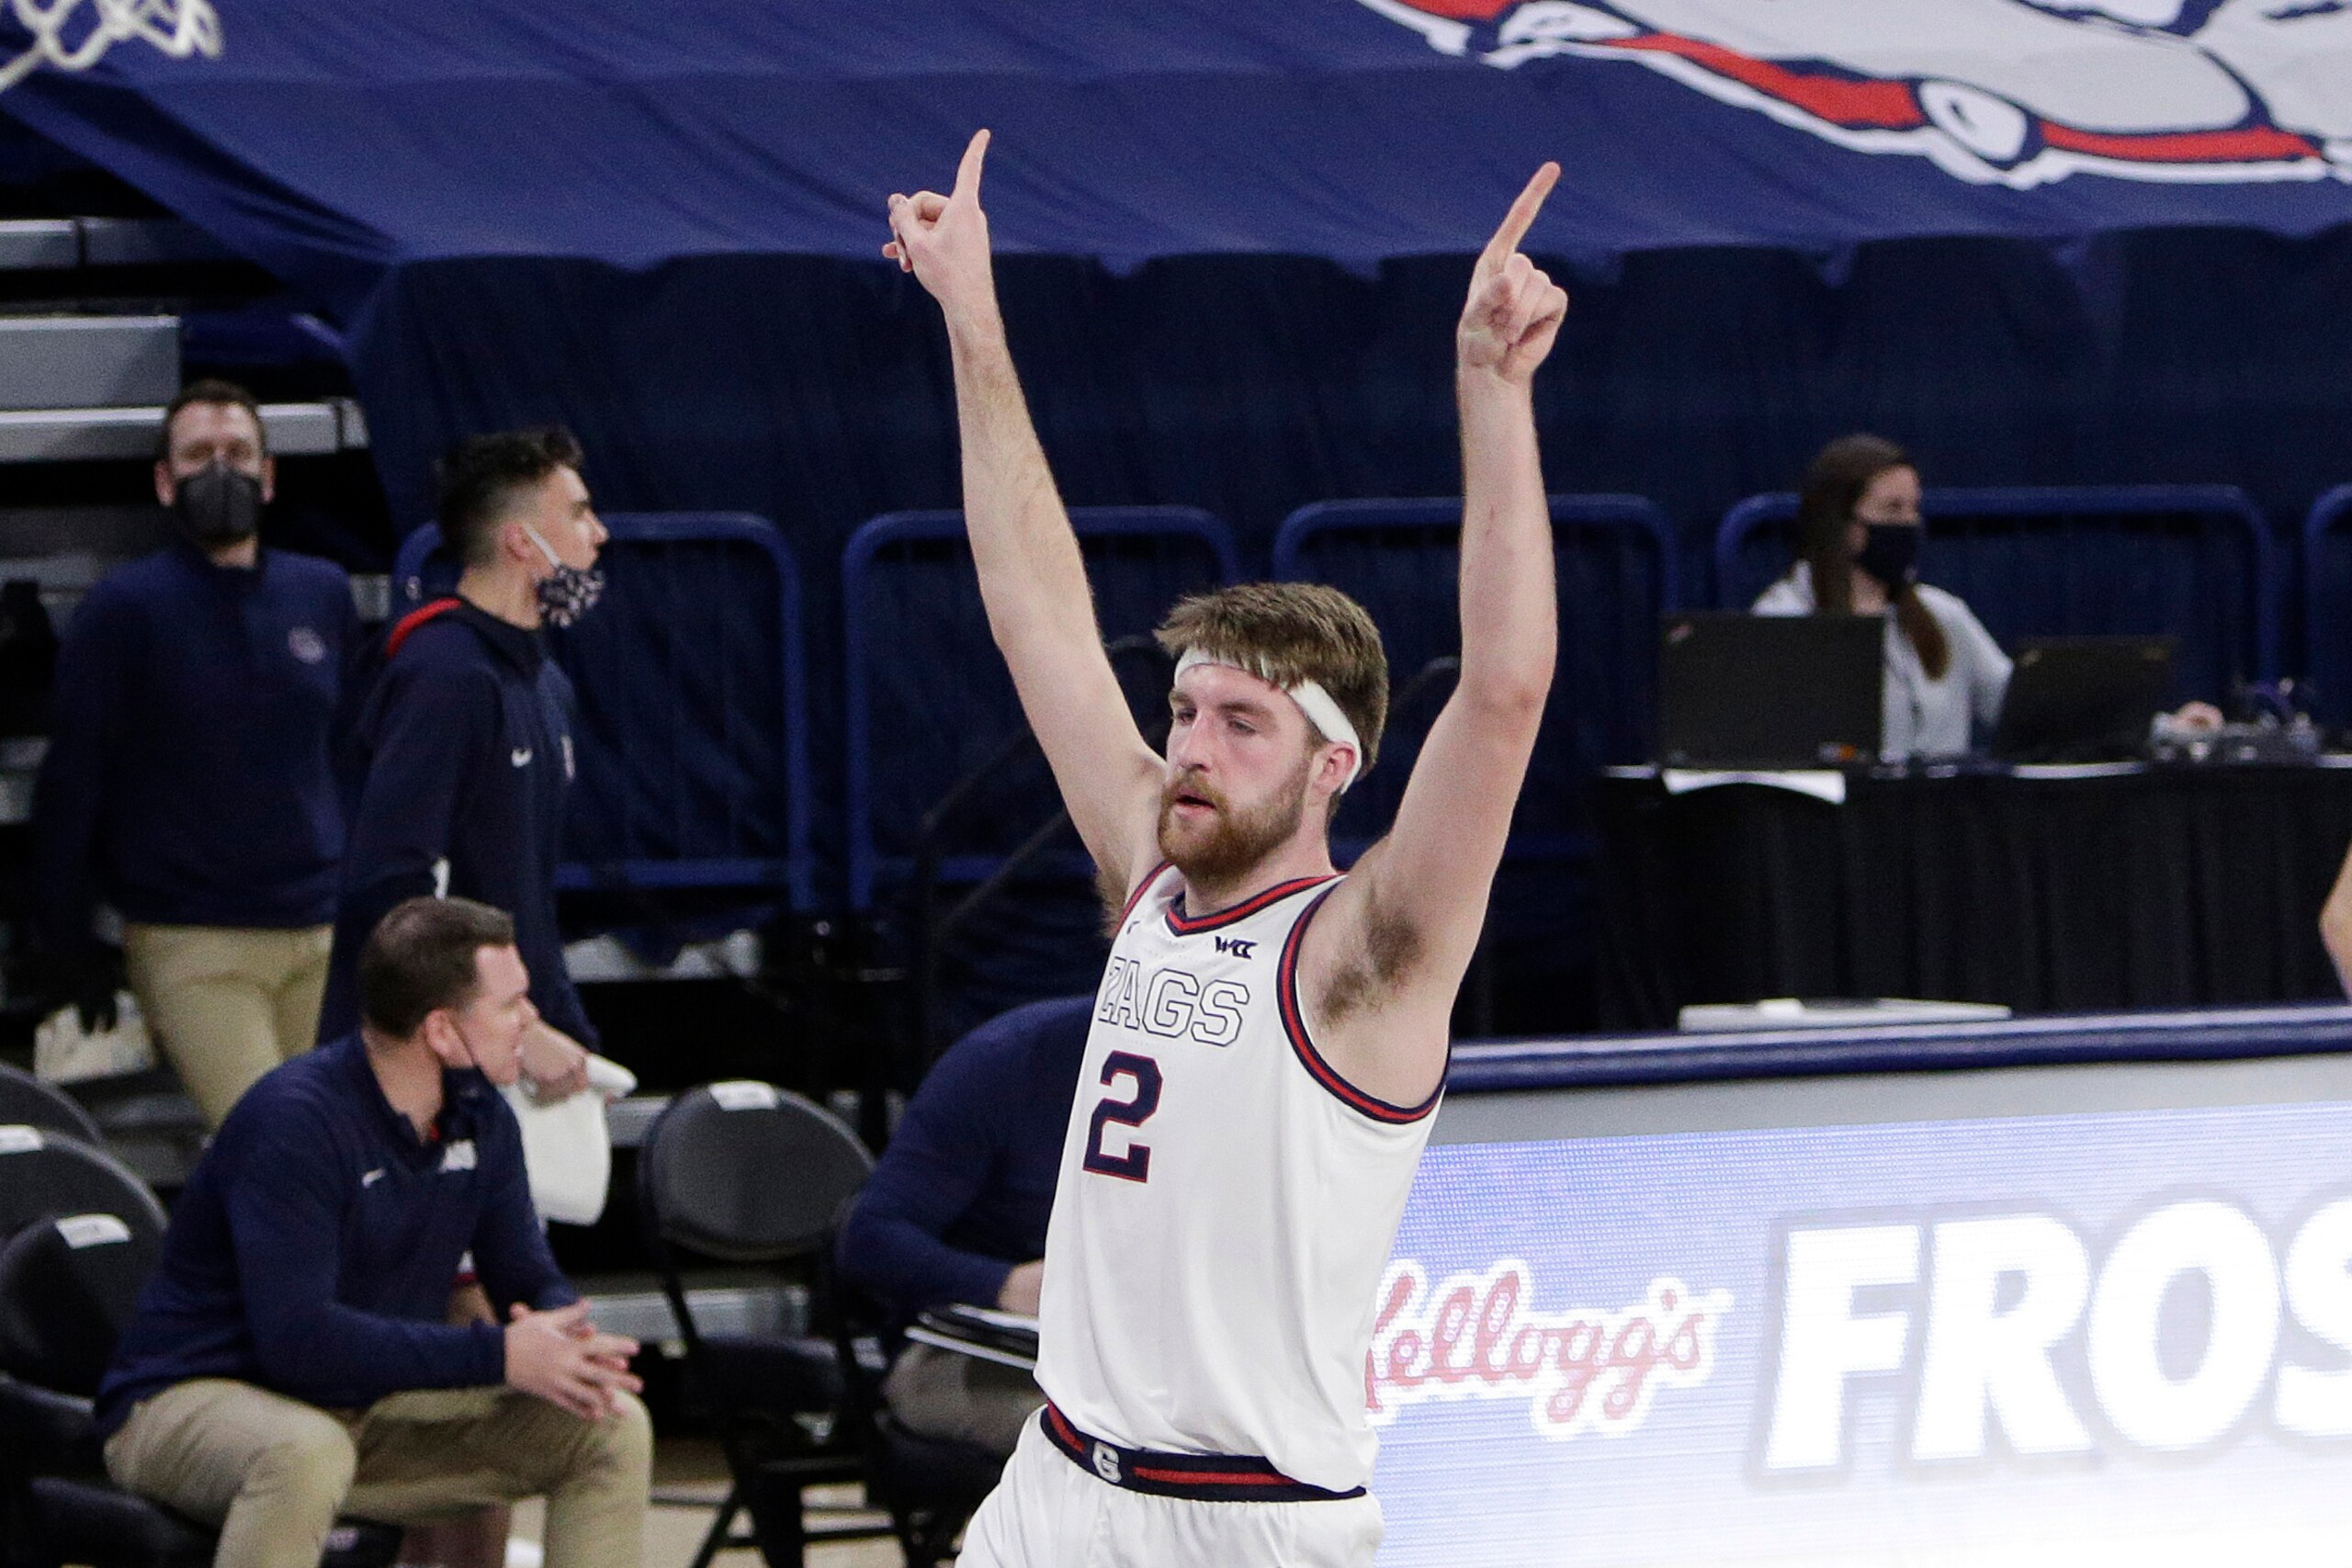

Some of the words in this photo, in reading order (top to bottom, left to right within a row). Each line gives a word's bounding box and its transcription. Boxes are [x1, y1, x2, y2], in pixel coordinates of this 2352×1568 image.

[1097, 955, 1250, 1047] ZAGS
[1082, 1049, 1163, 1183] 2
[1091, 1440, 1123, 1483] G
